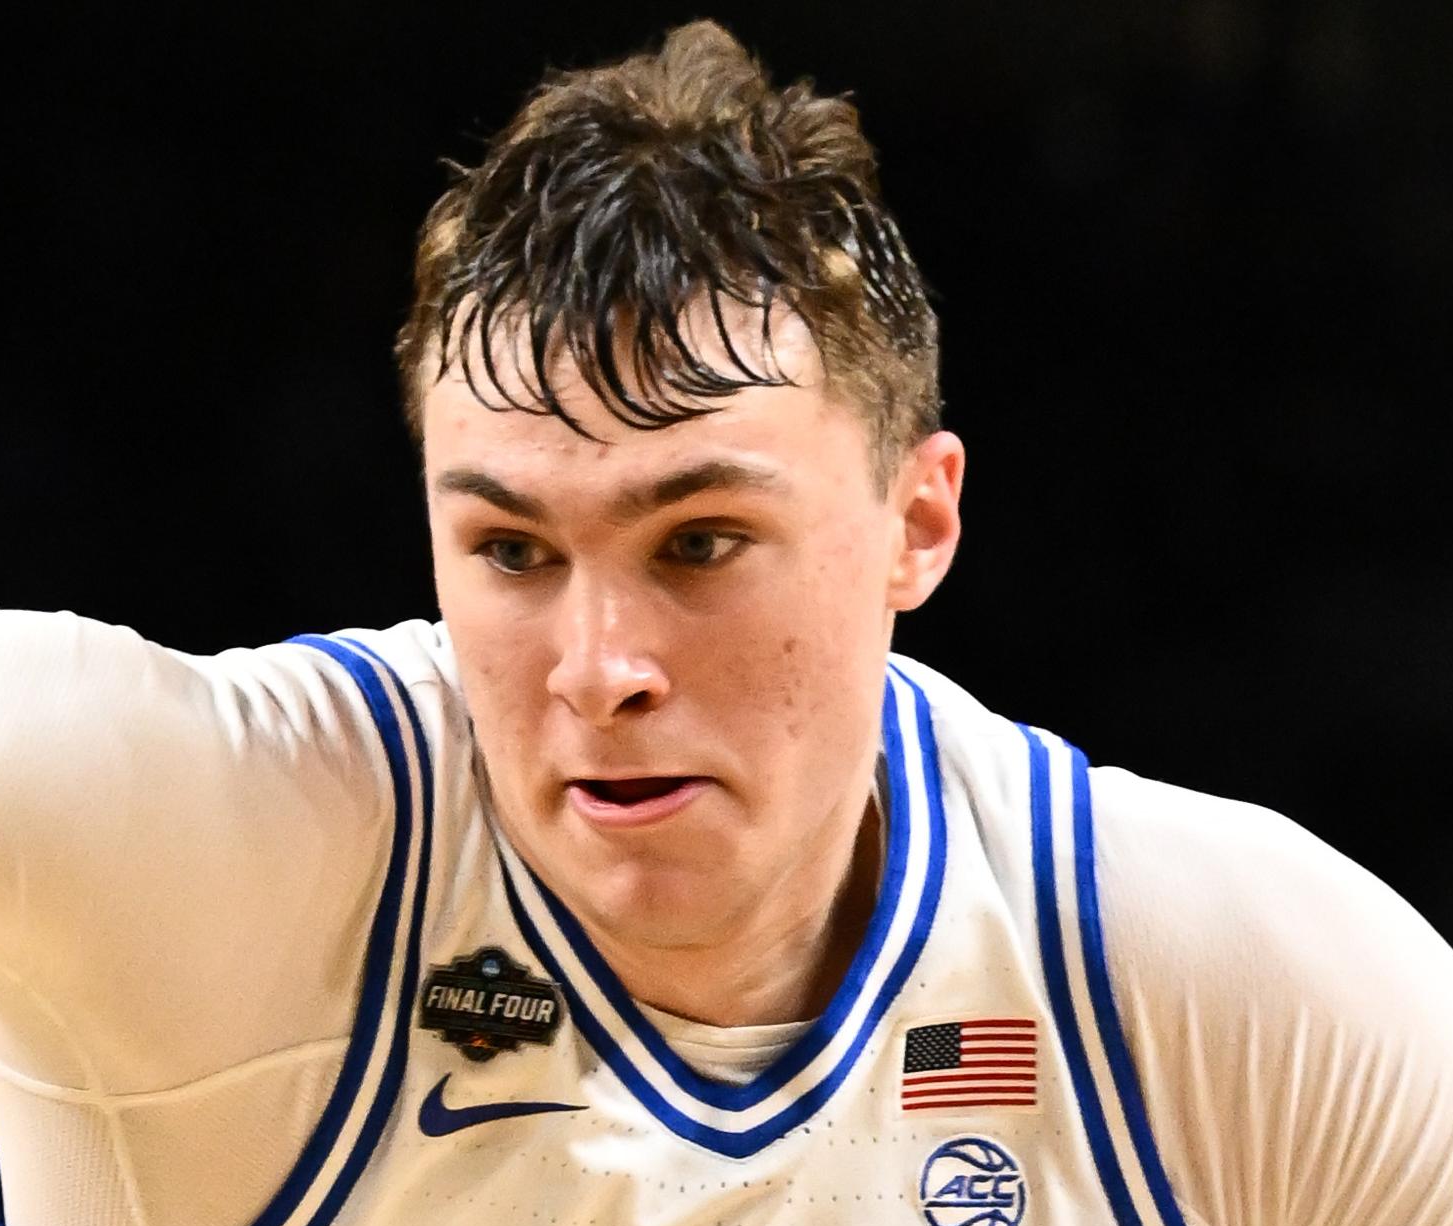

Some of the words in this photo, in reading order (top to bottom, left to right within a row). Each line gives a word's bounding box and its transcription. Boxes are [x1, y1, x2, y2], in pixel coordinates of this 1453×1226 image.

[425, 985, 485, 1015] FINAL
[489, 993, 556, 1023] FOUR
[933, 1173, 1021, 1200] ACC
